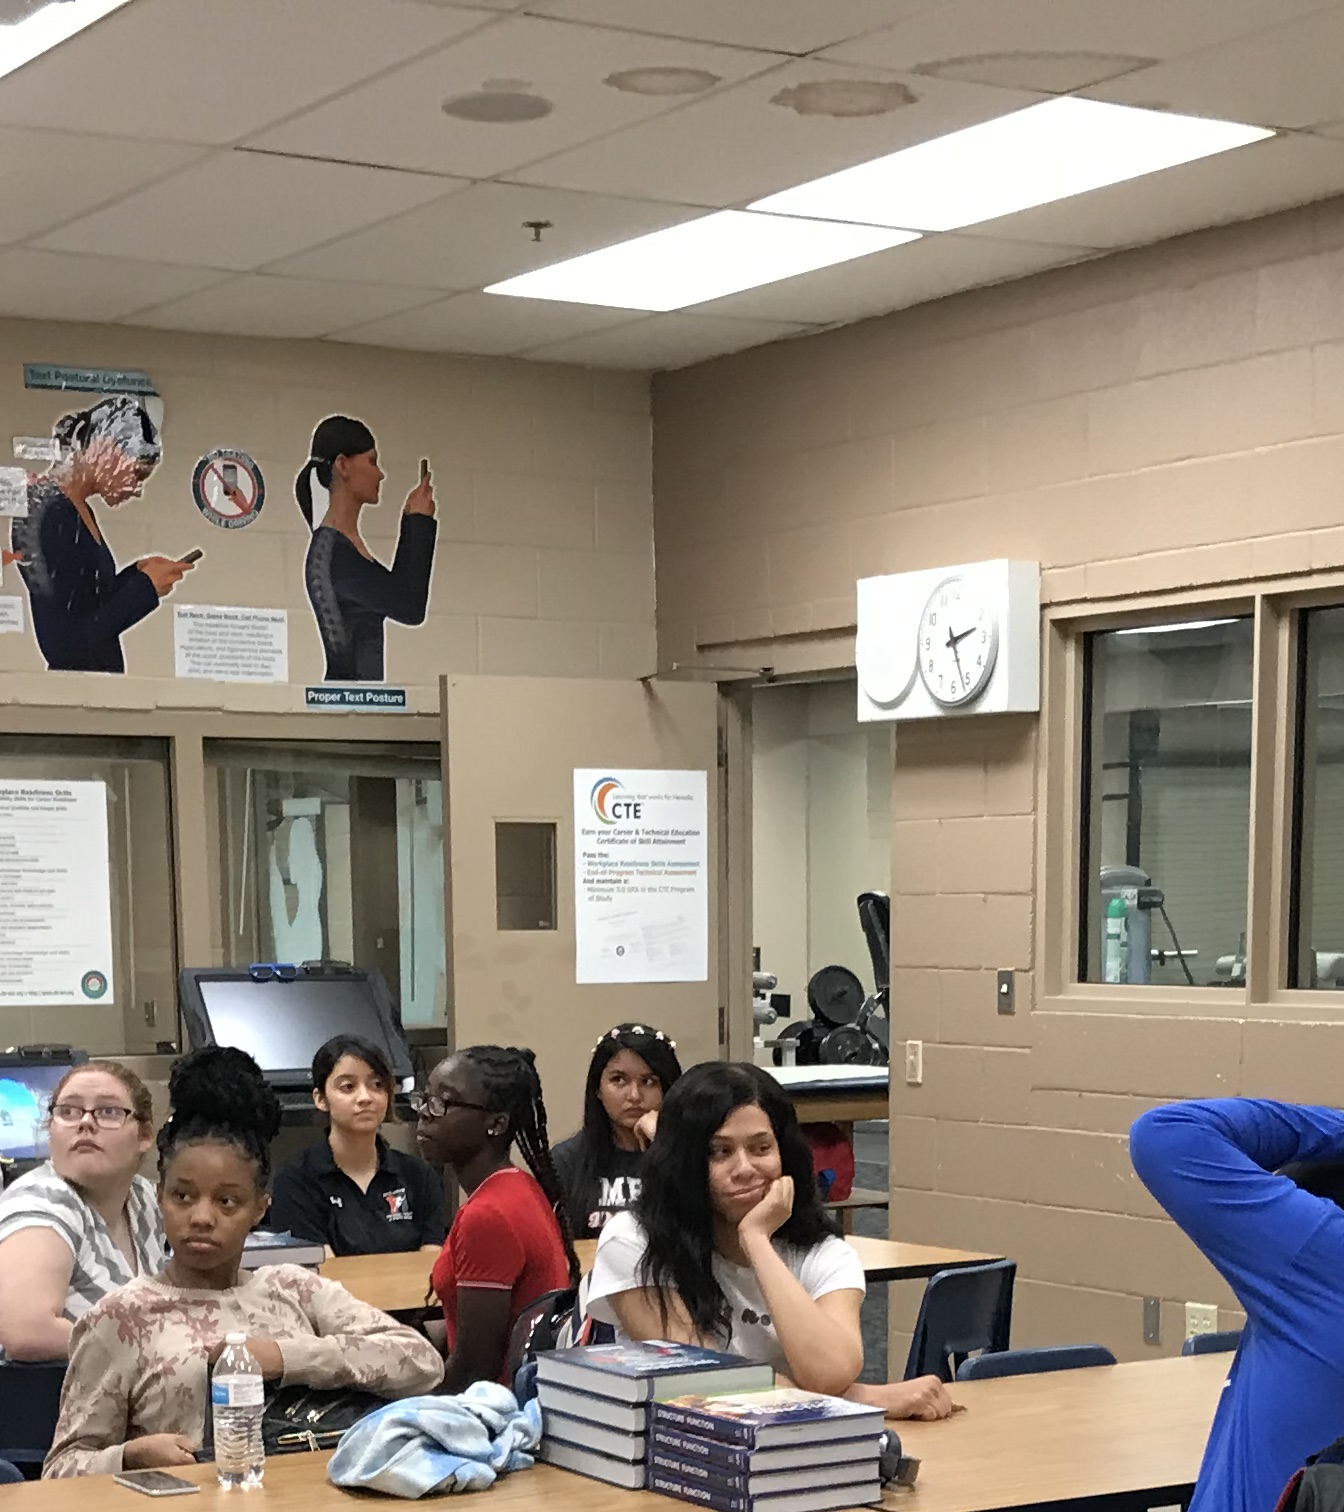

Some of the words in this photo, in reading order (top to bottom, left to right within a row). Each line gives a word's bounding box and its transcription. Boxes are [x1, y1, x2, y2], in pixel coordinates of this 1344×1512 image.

[929, 612, 937, 627] 10
[925, 637, 931, 651] 9
[980, 630, 987, 644] 3
[928, 659, 934, 673] 8
[975, 654, 982, 667] 4
[938, 674, 944, 689] 7
[964, 671, 971, 686] 5
[950, 680, 957, 694] 6
[307, 690, 341, 703] Proper
[343, 691, 364, 703] Text
[365, 692, 404, 704] Posture
[611, 802, 642, 820] CTE
[581, 828, 597, 836] Earn
[597, 829, 612, 837] your
[612, 828, 634, 836] Career
[634, 828, 640, 836] &
[641, 828, 670, 836] Technical
[670, 829, 701, 837] Education
[596, 837, 629, 845] Certificate
[629, 837, 637, 845] of
[652, 838, 687, 846] Attainment
[582, 851, 597, 859] Pass
[582, 877, 595, 885] And
